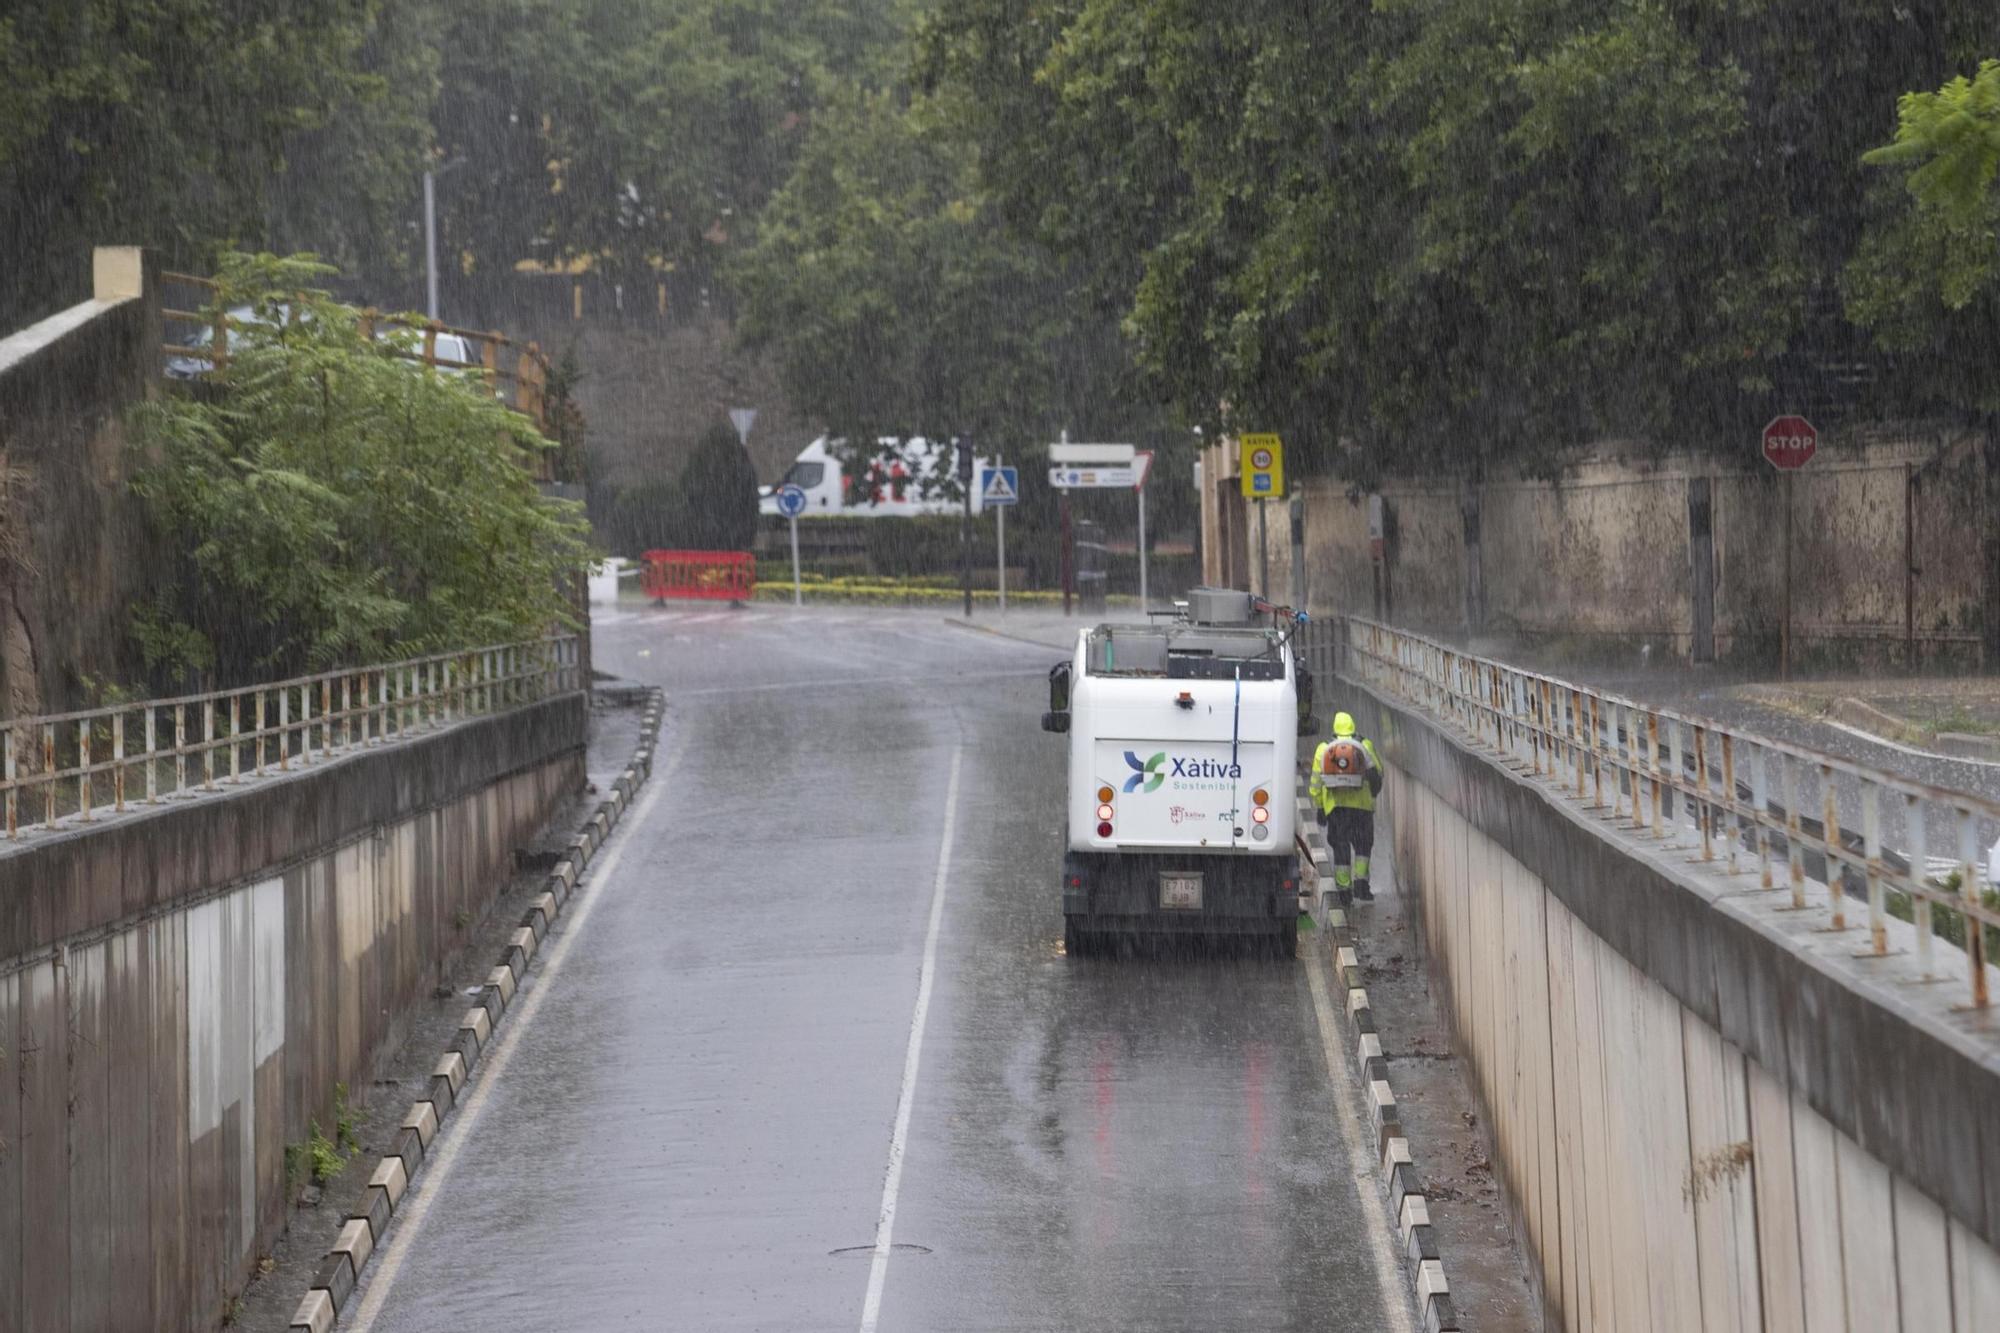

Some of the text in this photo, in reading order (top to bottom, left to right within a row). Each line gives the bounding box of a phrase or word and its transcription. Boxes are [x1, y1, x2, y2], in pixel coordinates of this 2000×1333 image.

[1768, 436, 1813, 449] STOP
[1171, 757, 1242, 778] Xàtiva
[1173, 781, 1237, 791] Sostenible
